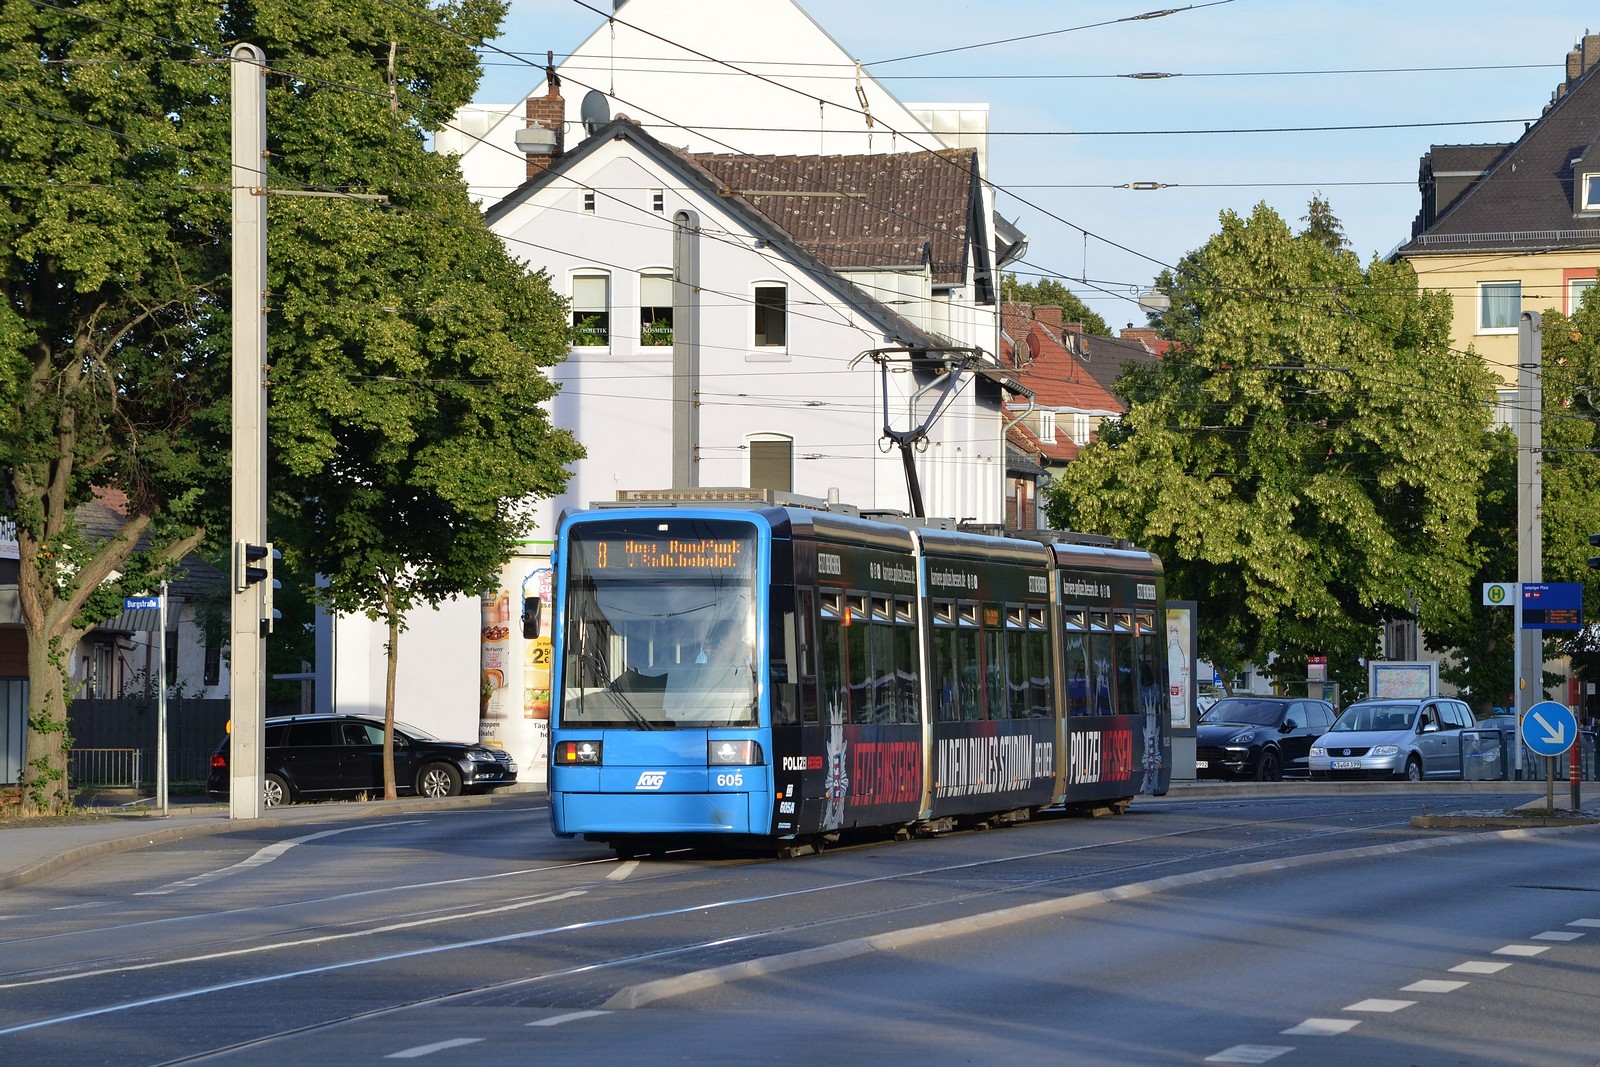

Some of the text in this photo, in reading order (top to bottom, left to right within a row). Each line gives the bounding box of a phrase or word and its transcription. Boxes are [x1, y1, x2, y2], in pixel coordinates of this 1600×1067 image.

[598, 541, 607, 569] 8
[127, 600, 157, 609] Burgstraße
[532, 648, 544, 664] 2
[1069, 730, 1133, 784] POLIZEI HESSEN
[936, 739, 948, 798] IN
[947, 737, 968, 797] DEIN
[967, 736, 999, 795] DUALES
[998, 734, 1033, 793] STUDIUM
[636, 773, 666, 788] KVG
[717, 774, 743, 787] 605
